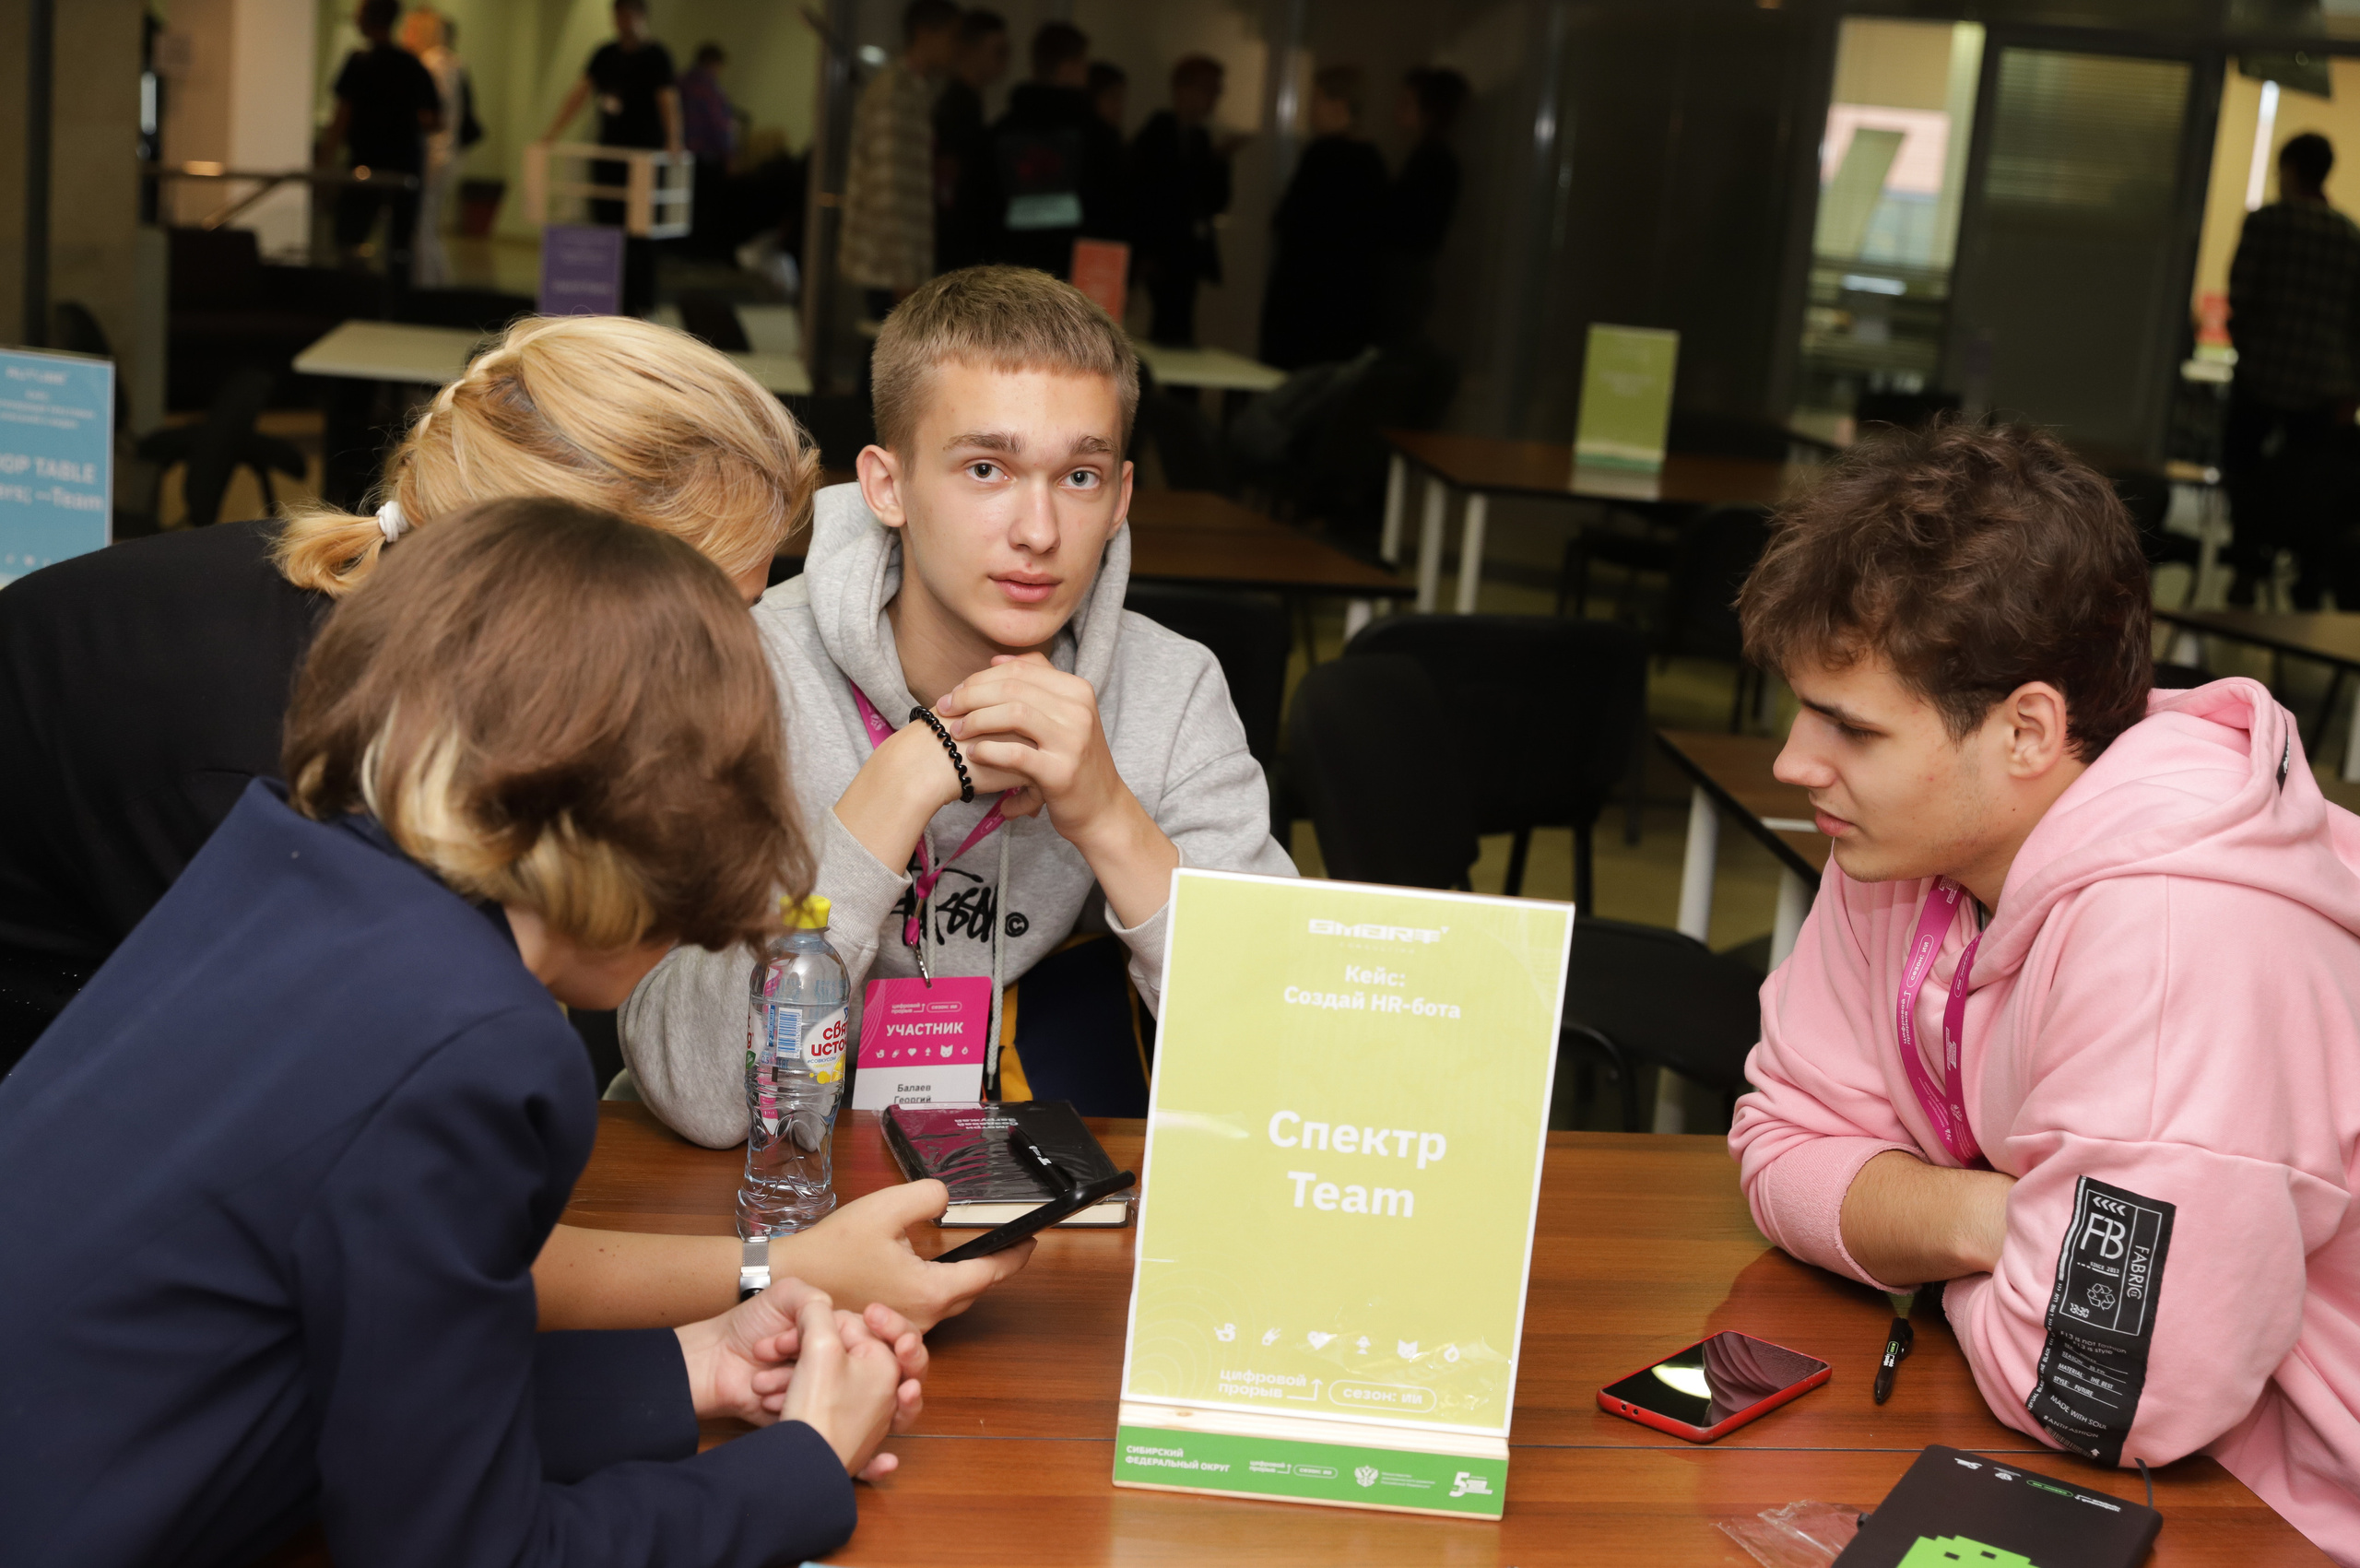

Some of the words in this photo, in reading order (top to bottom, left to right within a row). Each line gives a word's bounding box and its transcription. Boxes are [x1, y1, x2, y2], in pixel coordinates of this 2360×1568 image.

[1345, 964, 1406, 987] Кейс:
[1910, 954, 1925, 981] сезон:
[1284, 985, 1365, 1011] Создай
[1371, 993, 1461, 1020] HR-бота
[886, 1021, 964, 1037] УЧАСТНИК
[897, 1083, 931, 1092] Балаев
[893, 1095, 932, 1103] Георгий
[1268, 1110, 1447, 1170] Спектр
[1287, 1170, 1415, 1219] Team
[2127, 1244, 2150, 1300] FABRIC
[2097, 1342, 2127, 1354] fashion
[1219, 1370, 1306, 1386] цифровой
[2090, 1376, 2100, 1385] THE
[2102, 1381, 2114, 1390] BEST
[1218, 1382, 1283, 1398] прорыв
[1343, 1387, 1396, 1402] сезон:
[2074, 1384, 2094, 1397] FUTURE
[2049, 1395, 2071, 1413] MADE
[2070, 1409, 2088, 1423] WITH
[2088, 1419, 2107, 1430] SOUL
[2043, 1415, 2099, 1438] #ANTIFASHION
[1126, 1444, 1184, 1458] СИБИРСКИЙ
[1125, 1456, 1198, 1470] ФЕДЕРАЛЬНЫЙ
[1200, 1462, 1231, 1473] ОКРУГ
